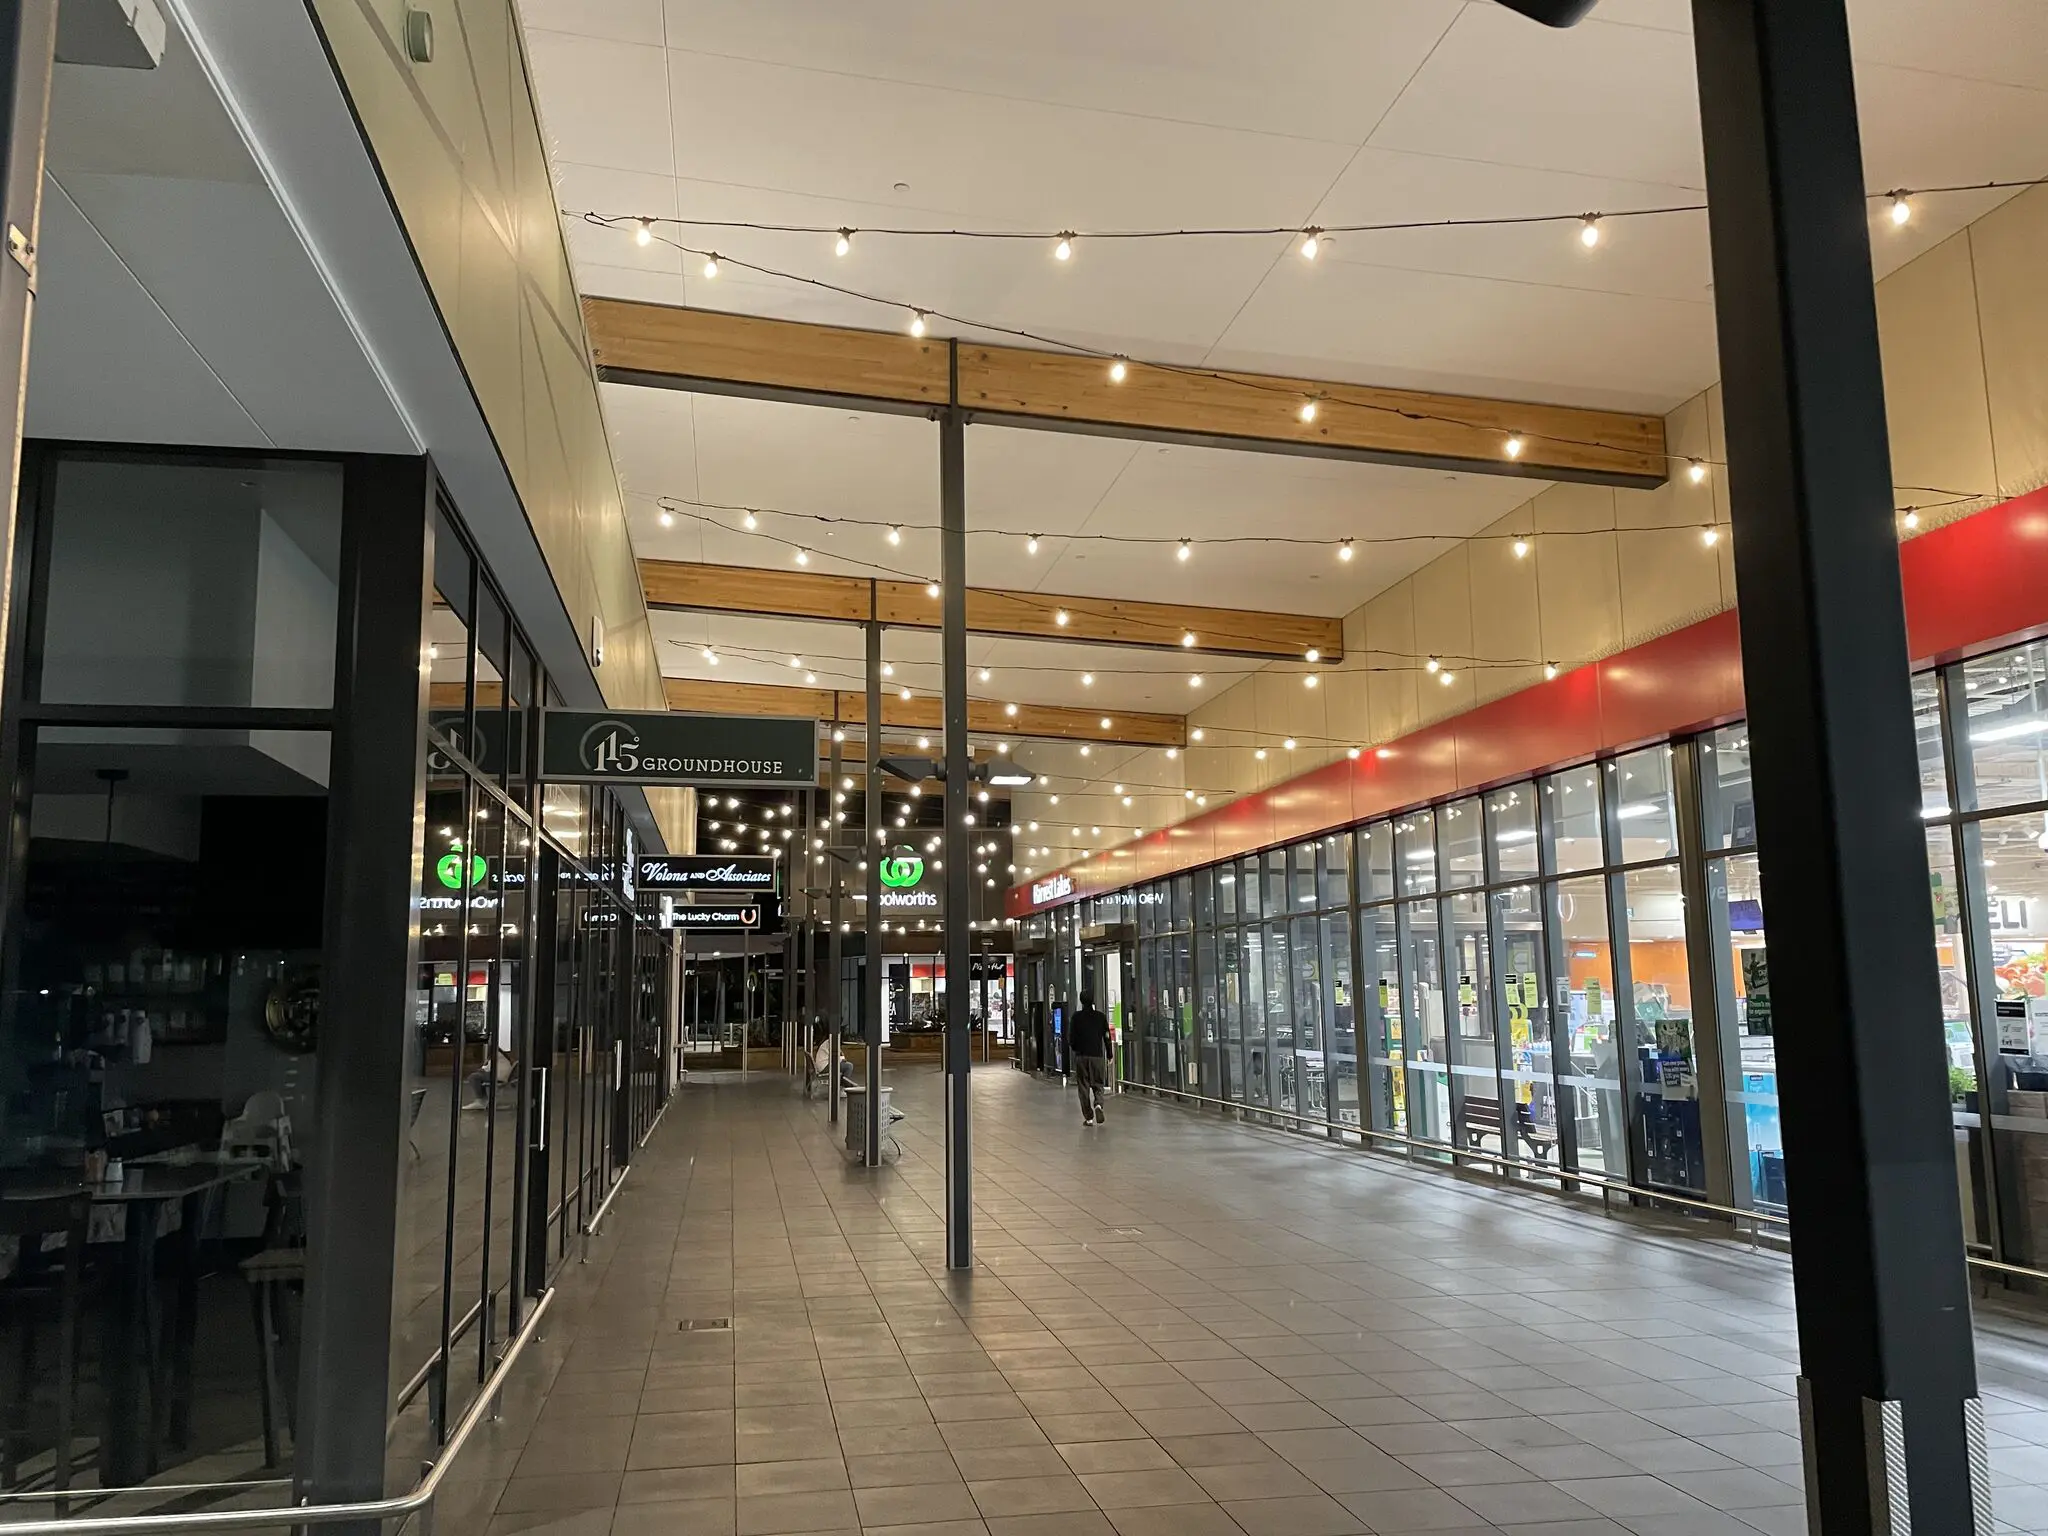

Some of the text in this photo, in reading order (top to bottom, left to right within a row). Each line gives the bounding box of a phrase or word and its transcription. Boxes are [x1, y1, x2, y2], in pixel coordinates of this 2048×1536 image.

[642, 758, 783, 774] GROUNDHOUSE
[641, 862, 689, 881] Volona
[705, 863, 772, 882] Associates
[880, 890, 938, 906] oolworths
[672, 912, 687, 921] The
[687, 912, 711, 922] Lucky
[711, 912, 740, 921] Charm
